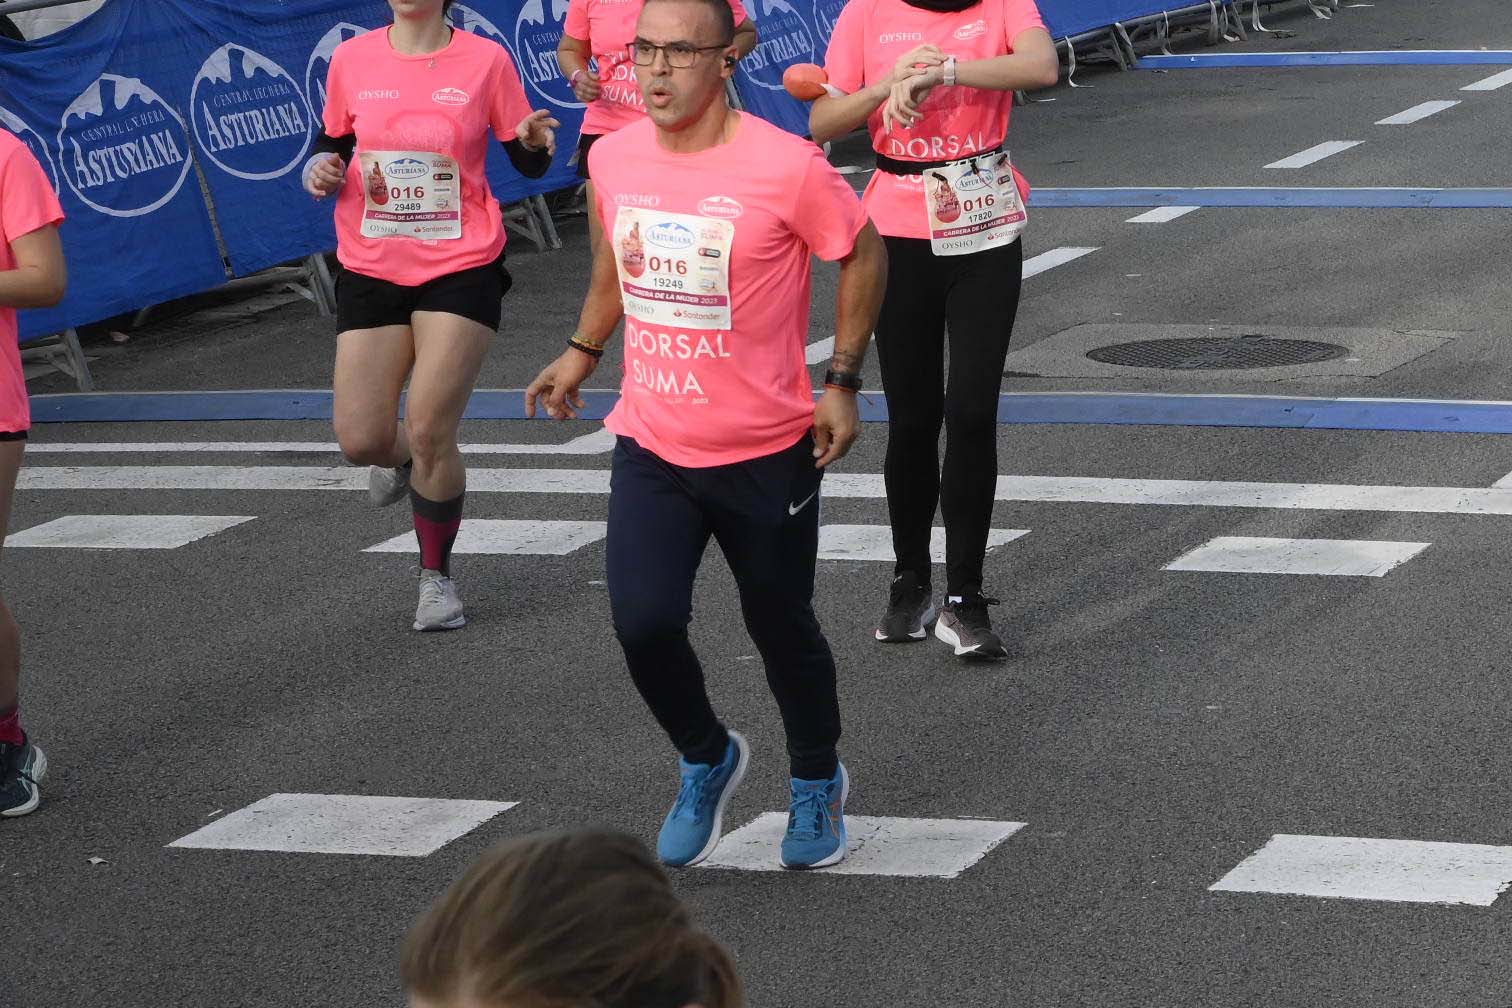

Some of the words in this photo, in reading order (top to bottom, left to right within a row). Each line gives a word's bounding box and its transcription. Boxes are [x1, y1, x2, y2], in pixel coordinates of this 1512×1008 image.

[879, 31, 922, 43] OYSHO
[358, 90, 400, 100] OYSHO
[601, 85, 638, 106] SUM
[202, 101, 307, 152] ASTURIANA
[890, 133, 986, 158] DORSAL
[391, 186, 425, 199] 016
[394, 203, 421, 211] 29489
[613, 193, 660, 207] OYSHO
[963, 194, 996, 212] 016
[968, 211, 993, 224] 17820
[942, 239, 973, 250] OYSHO
[649, 256, 688, 275] 016
[653, 277, 684, 290] 19249
[628, 322, 731, 360] DORSAL
[633, 358, 704, 395] SUMA
